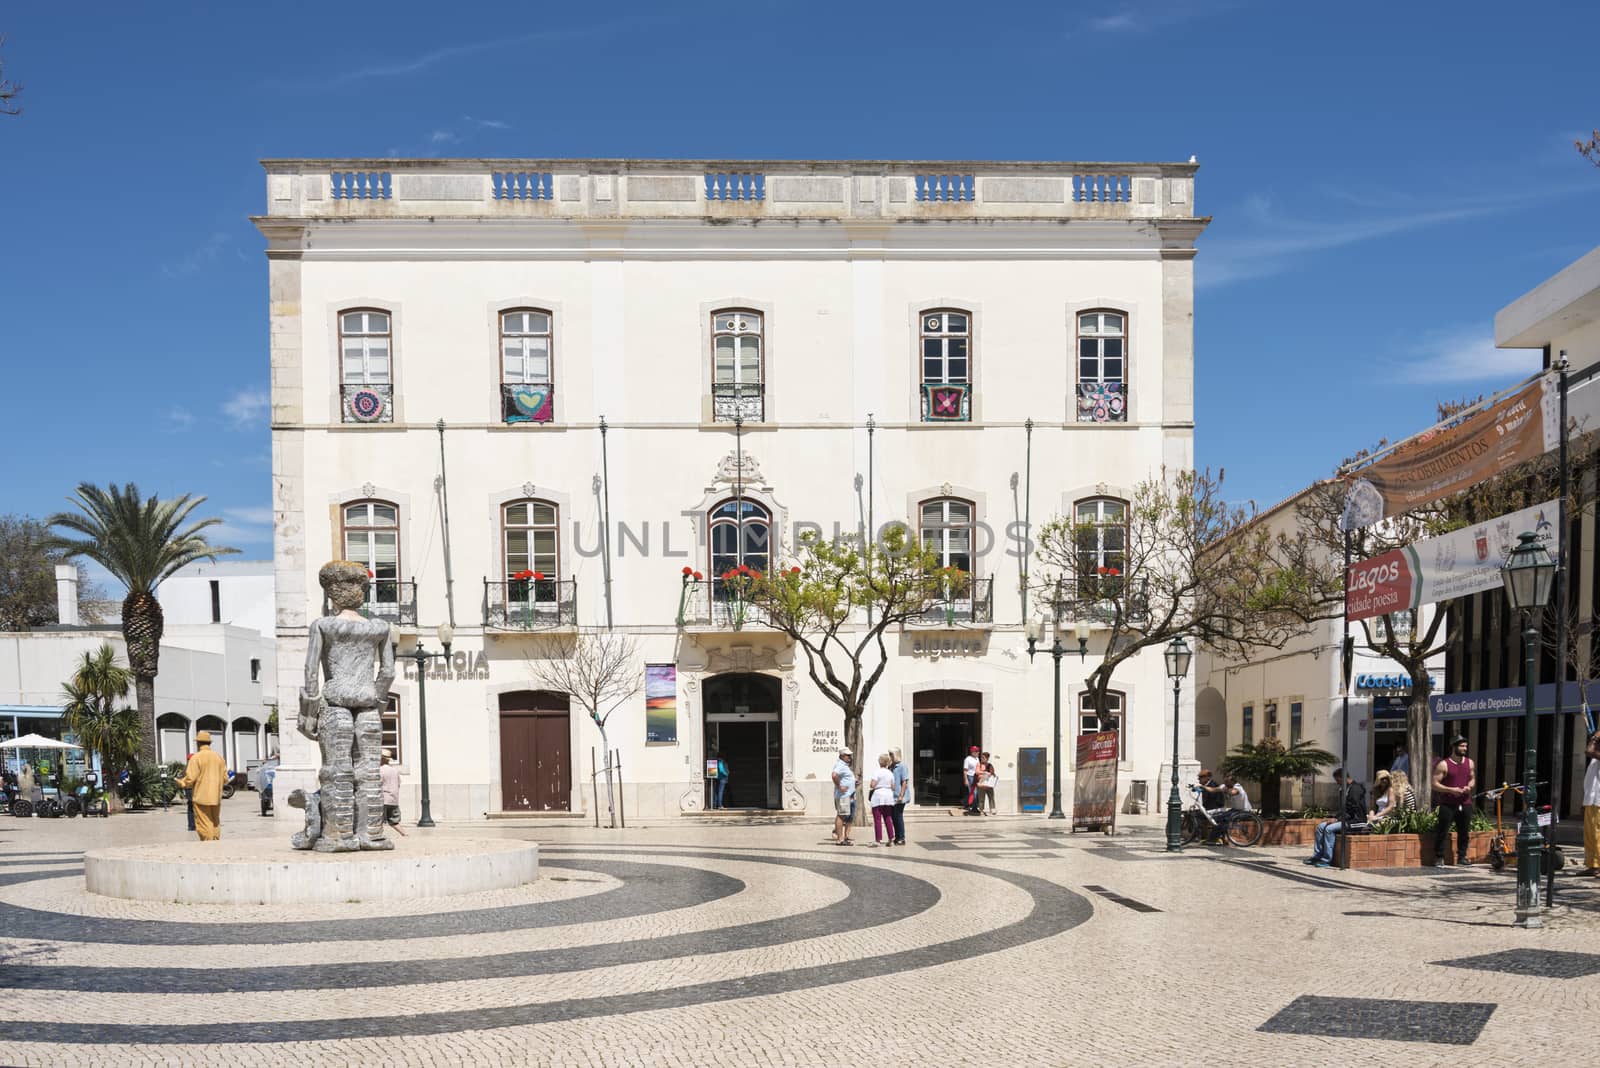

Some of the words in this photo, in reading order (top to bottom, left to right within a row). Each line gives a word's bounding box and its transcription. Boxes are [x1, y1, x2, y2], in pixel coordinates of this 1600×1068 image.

[1348, 560, 1399, 594] Lagos
[1347, 594, 1371, 614] cidade
[1373, 587, 1399, 613] poesia
[403, 650, 489, 672] POLCIA
[1444, 702, 1460, 712] Caixa
[1461, 700, 1478, 711] Geral
[1479, 700, 1487, 710] de
